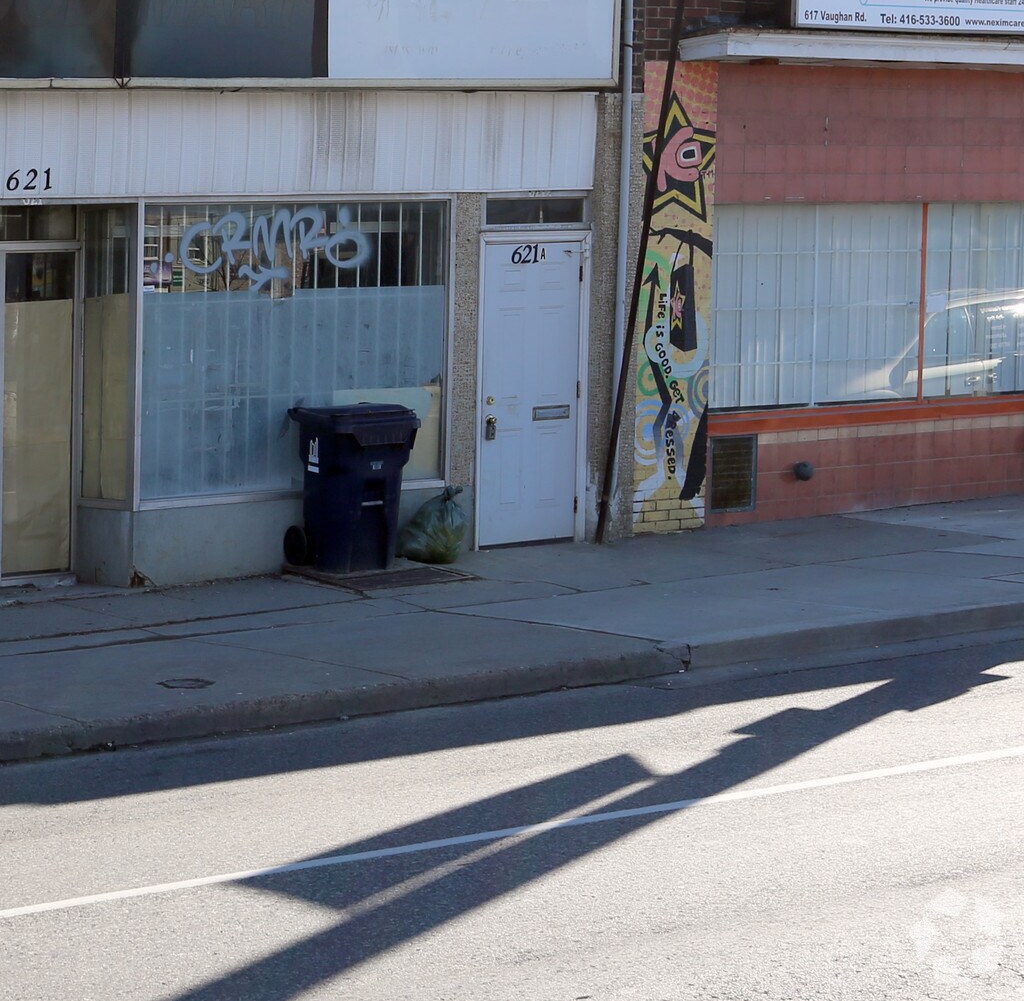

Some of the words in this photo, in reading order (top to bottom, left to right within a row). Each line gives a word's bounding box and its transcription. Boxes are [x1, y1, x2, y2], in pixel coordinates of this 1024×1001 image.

[804, 10, 818, 21] 617
[820, 11, 853, 25] Vaughan
[854, 12, 867, 23] Rd.
[880, 13, 897, 25] Tel:
[900, 14, 960, 27] 416-533-3600
[6, 167, 52, 191] 621
[655, 343, 672, 379] GOOD.
